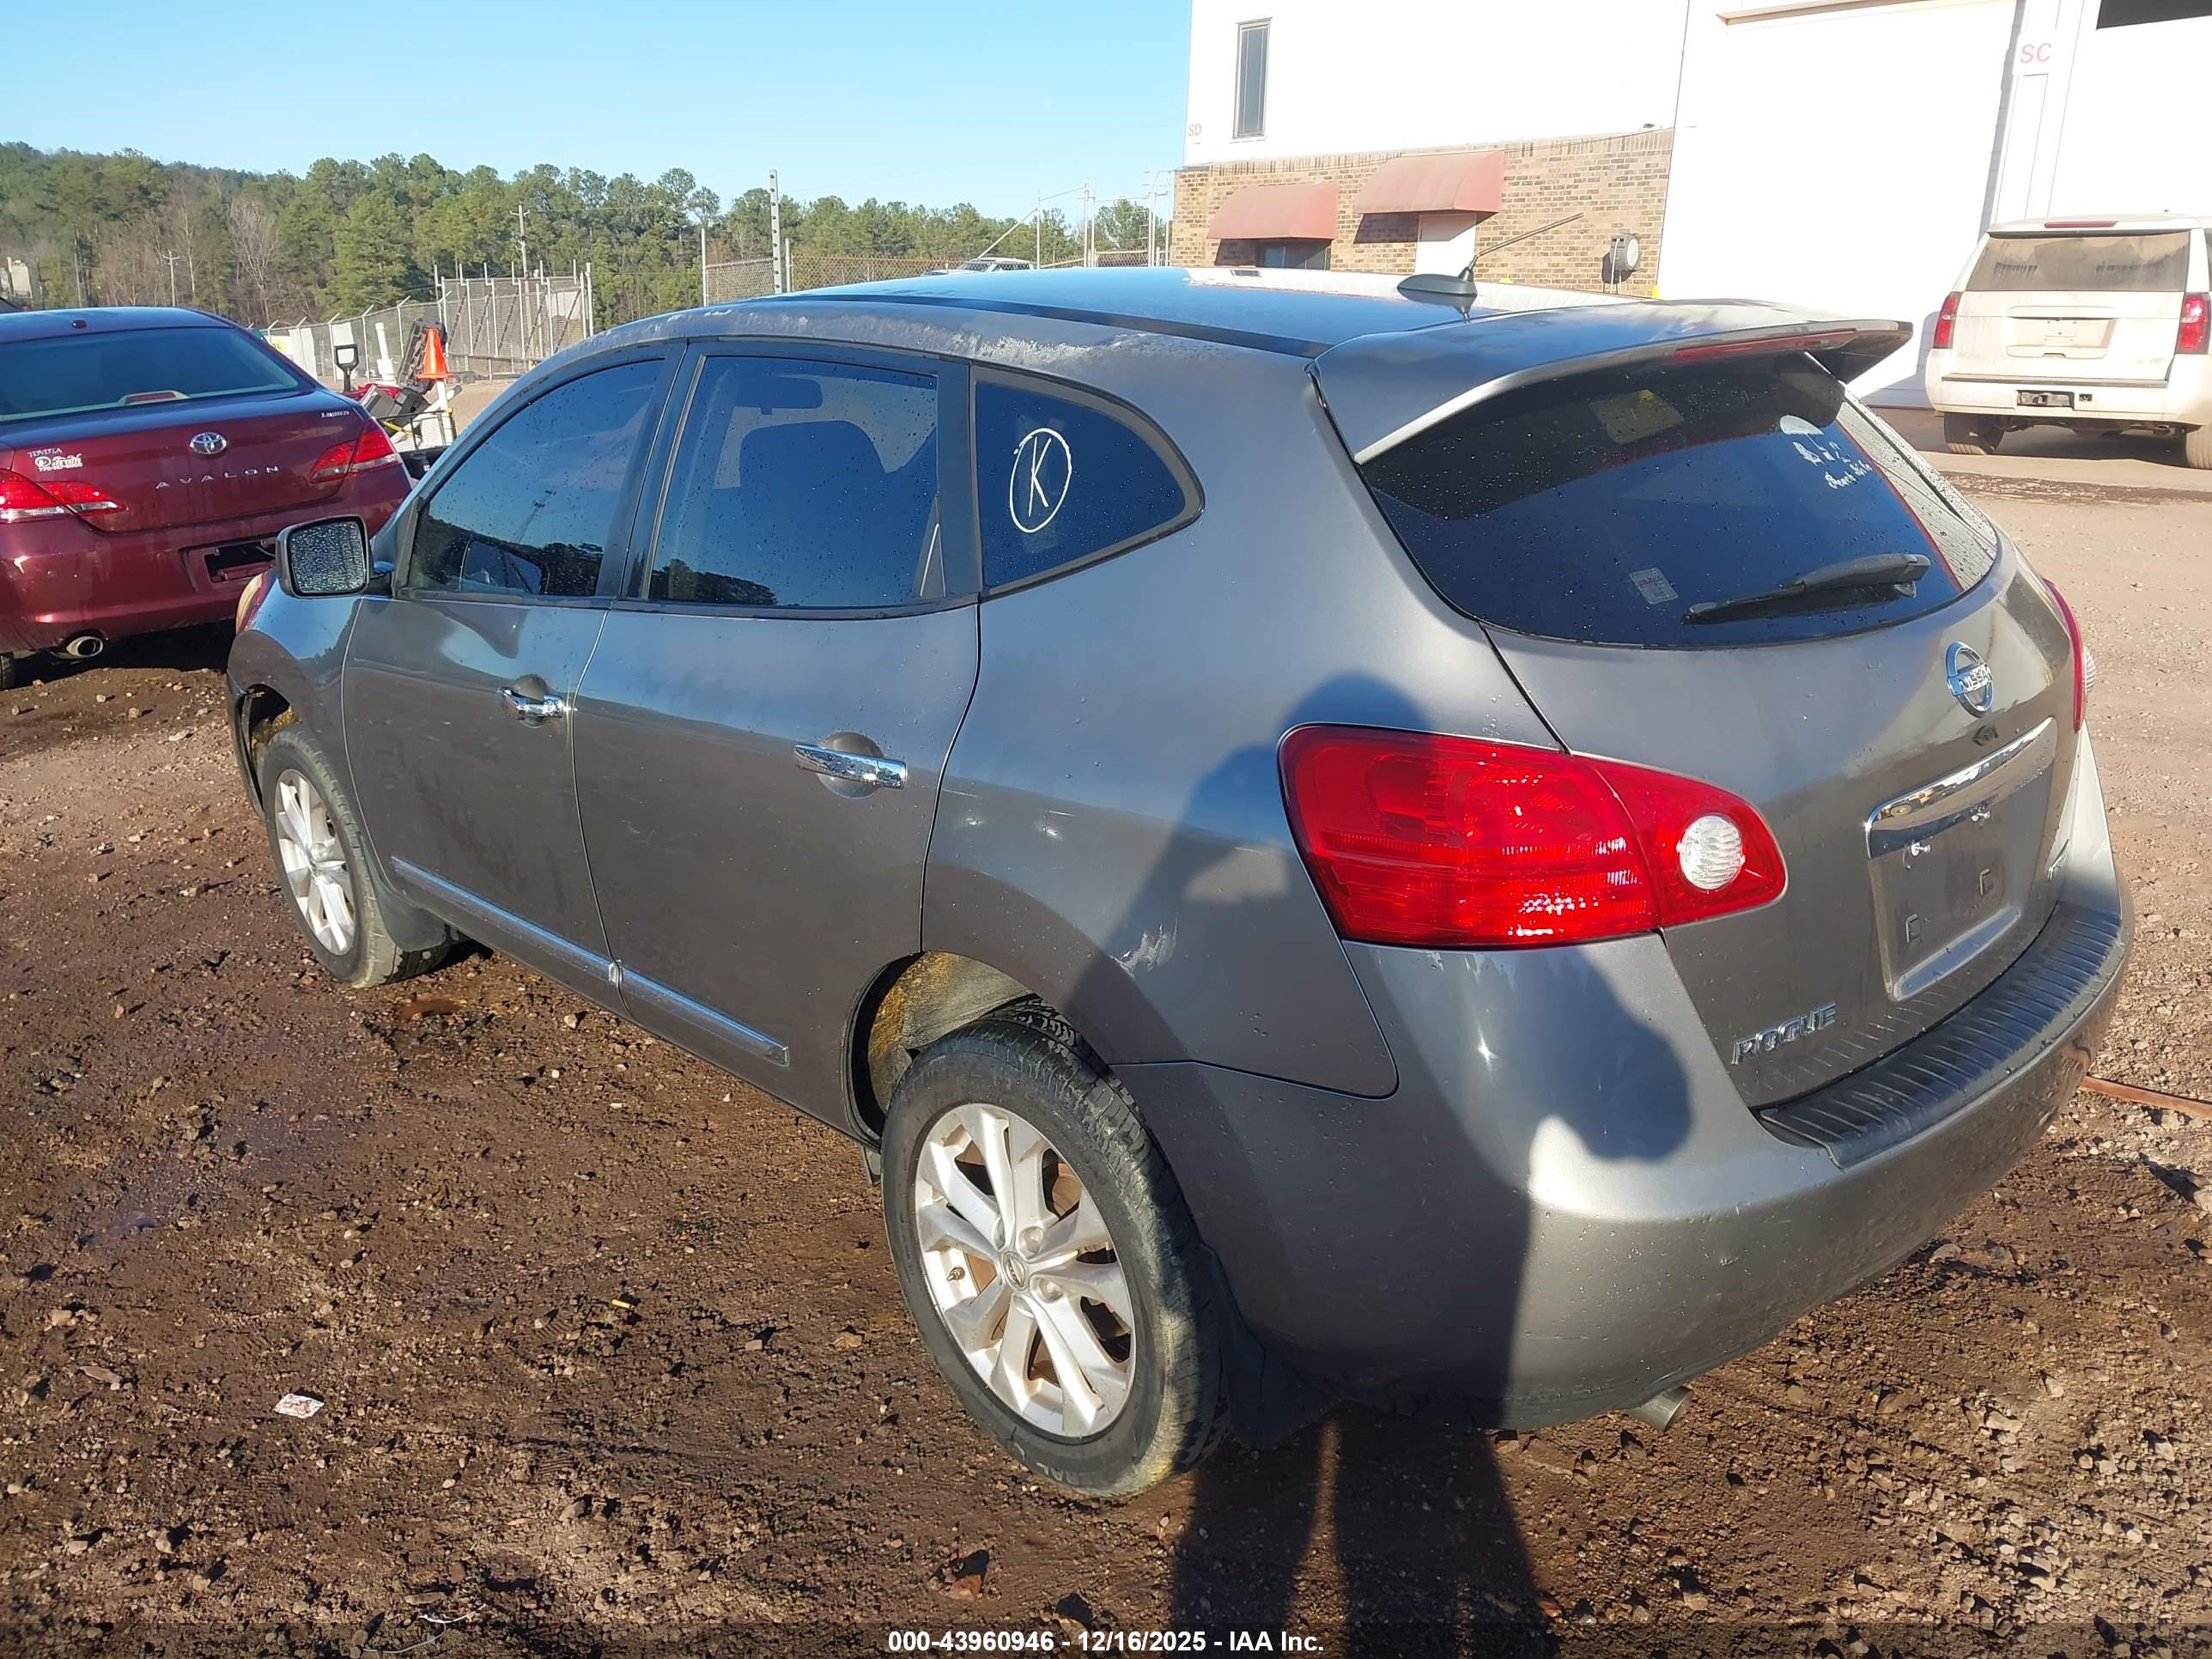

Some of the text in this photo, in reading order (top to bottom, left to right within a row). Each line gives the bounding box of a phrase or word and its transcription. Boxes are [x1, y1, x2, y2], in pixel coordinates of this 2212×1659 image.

[2020, 42, 2052, 64] SC
[1188, 123, 1202, 137] SD
[27, 447, 63, 459] TOYOTA
[155, 465, 279, 489] AVALON
[1029, 436, 1052, 517] K
[1959, 665, 1993, 692] NISSAN
[1731, 1002, 1837, 1065] ROGUE
